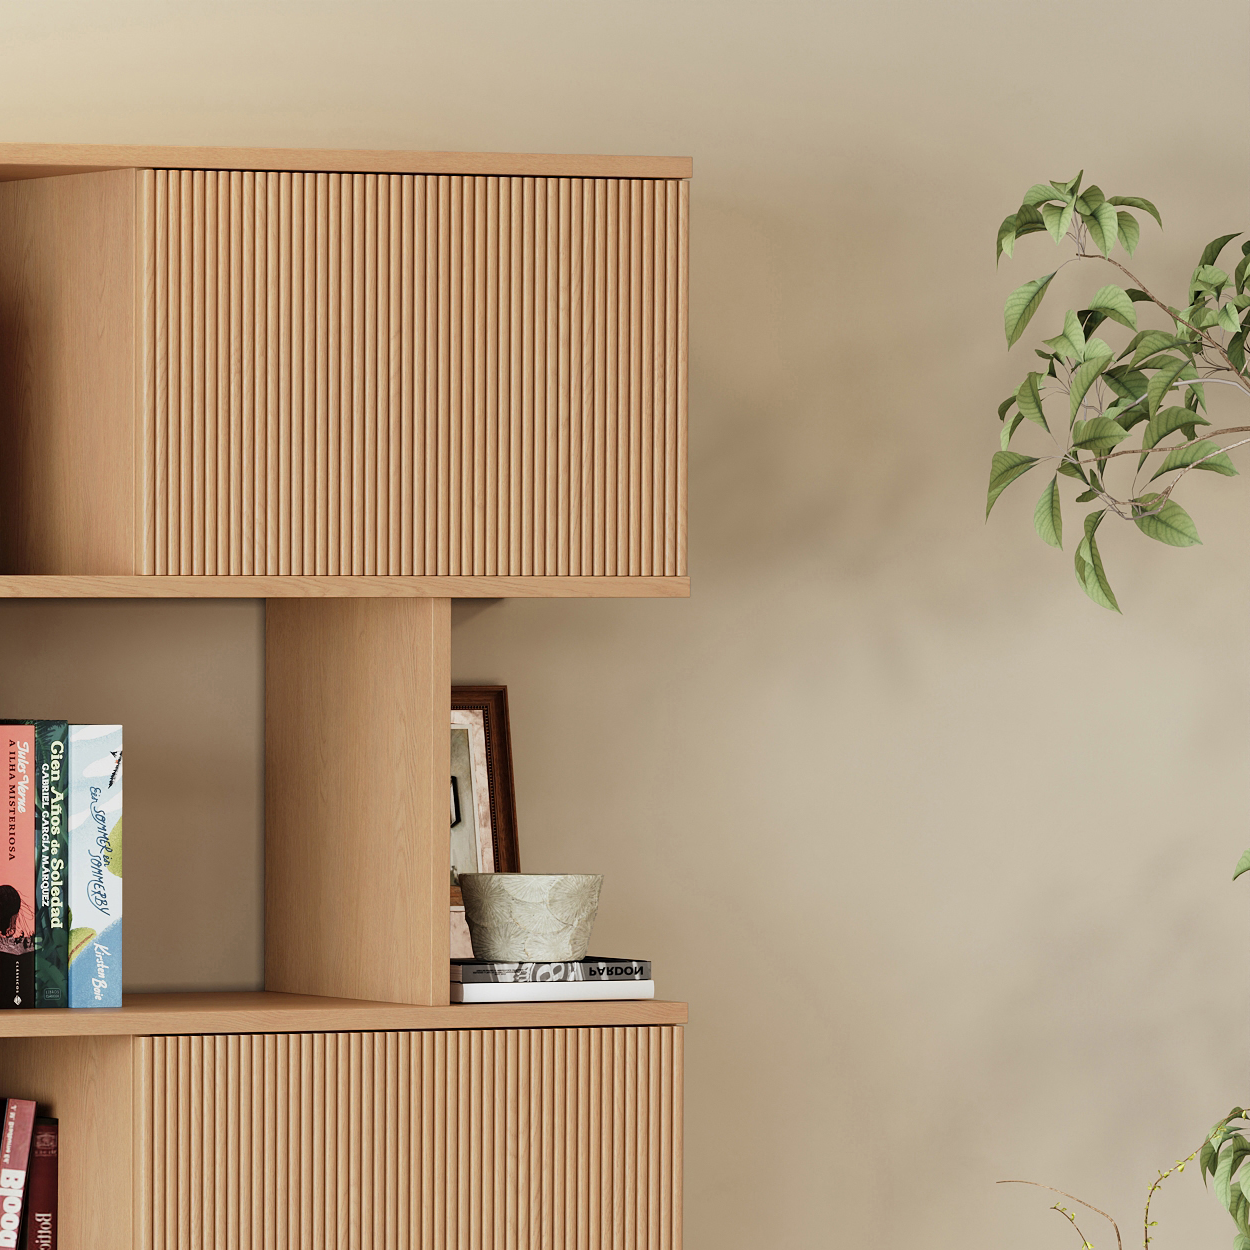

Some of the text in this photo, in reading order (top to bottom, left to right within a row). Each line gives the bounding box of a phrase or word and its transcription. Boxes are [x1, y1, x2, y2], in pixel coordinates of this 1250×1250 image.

[17, 741, 29, 813] Jules Verne
[42, 811, 50, 852] GARCÍA
[51, 741, 64, 928] Cien Años de Soledad
[41, 855, 49, 907] MÁRQUEZ
[92, 942, 111, 1000] Kirsten Boie
